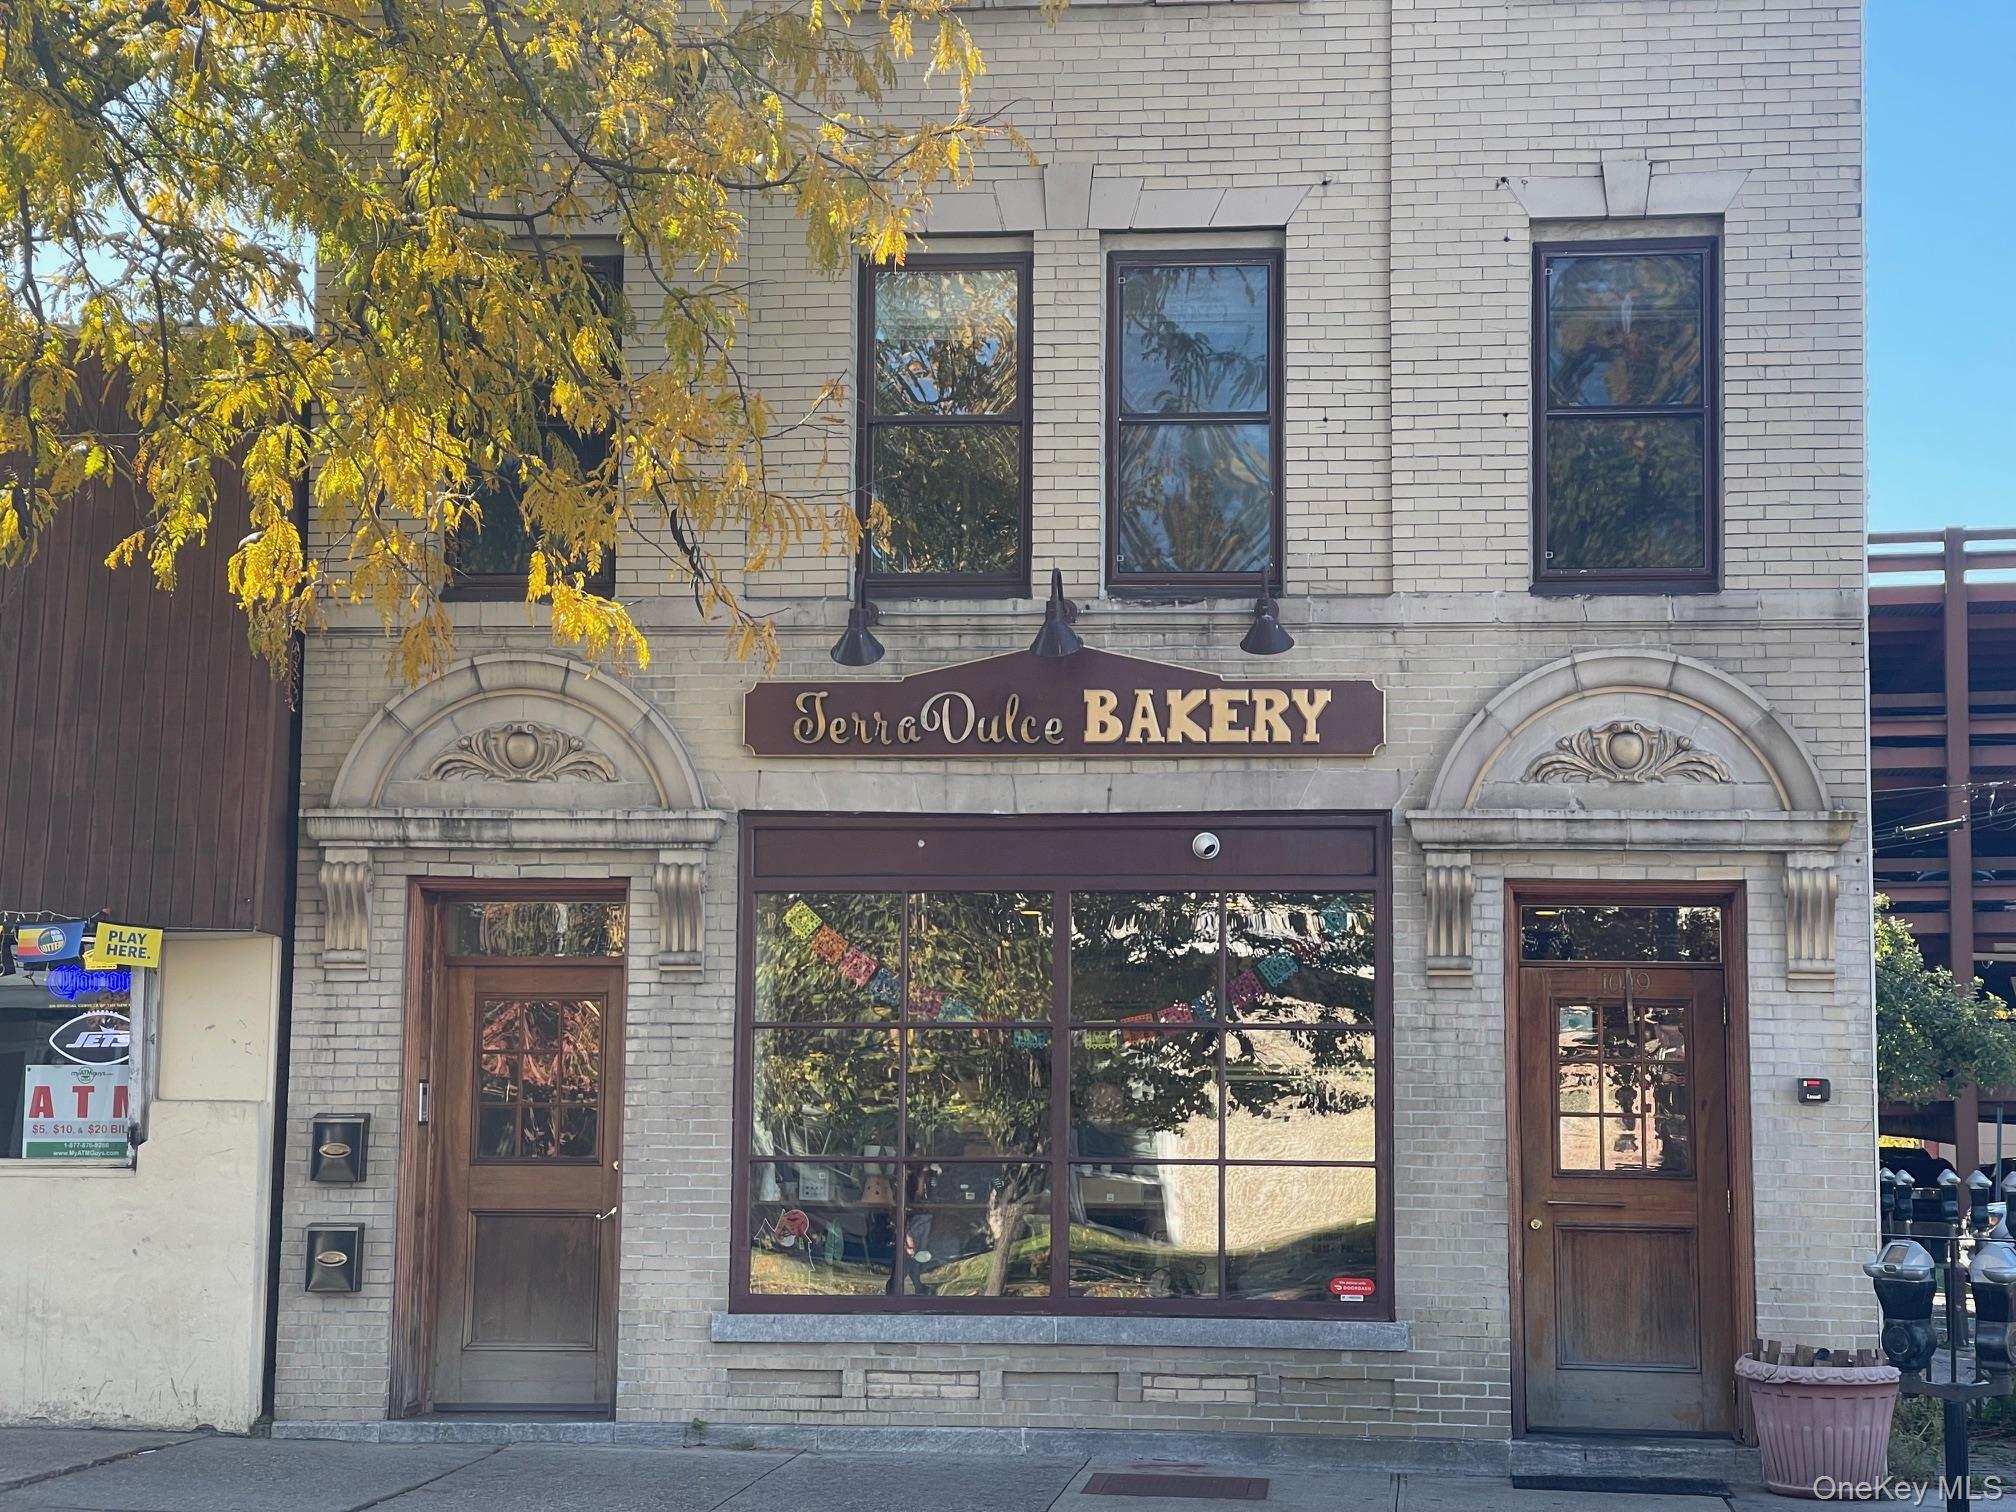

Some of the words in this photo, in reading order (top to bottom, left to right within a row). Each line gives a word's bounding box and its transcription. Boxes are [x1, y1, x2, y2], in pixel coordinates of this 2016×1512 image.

[1083, 688, 1333, 744] BAKERY
[109, 930, 147, 945] PLAY
[106, 944, 151, 960] HERE.
[1602, 972, 1650, 993] 109
[65, 1031, 131, 1049] JETS
[88, 1124, 107, 1135] $20
